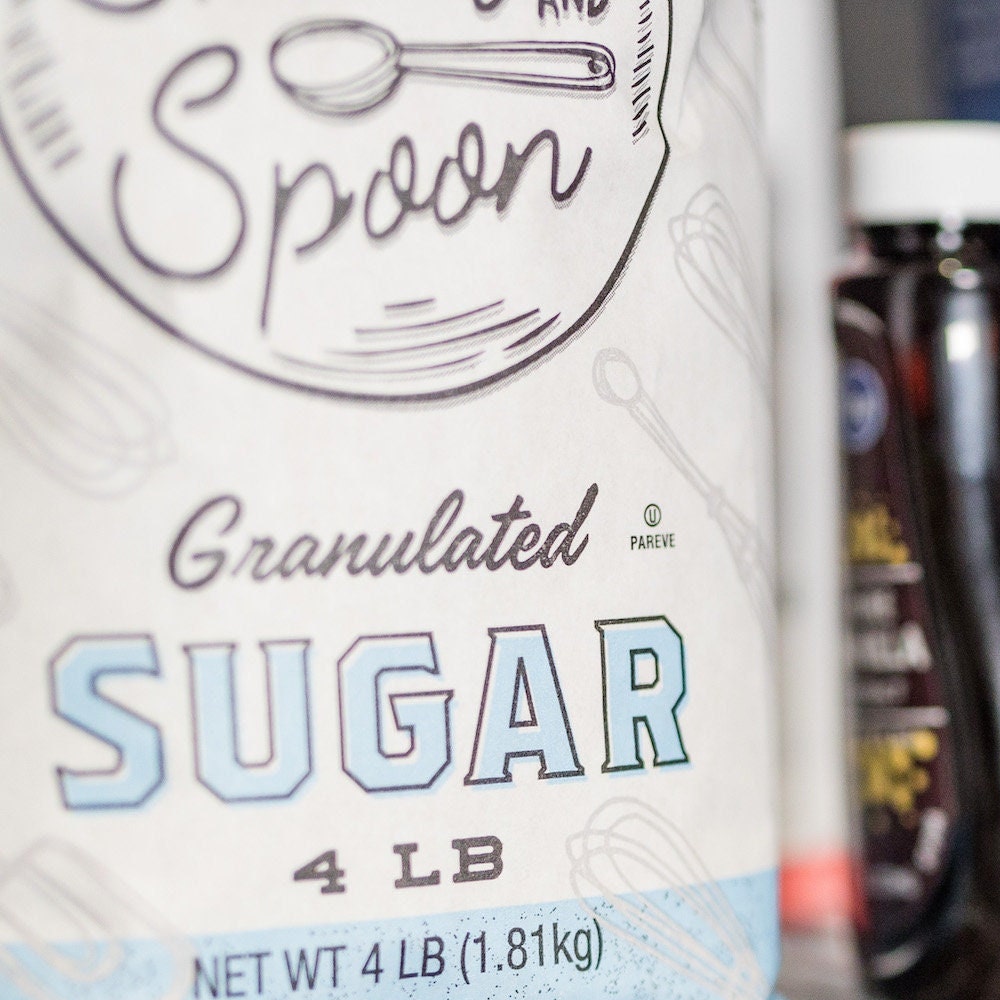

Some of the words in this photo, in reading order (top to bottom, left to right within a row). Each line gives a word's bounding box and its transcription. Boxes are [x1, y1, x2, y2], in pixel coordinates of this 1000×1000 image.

[112, 44, 593, 336] Spoon
[168, 482, 600, 591] Granulated
[630, 533, 676, 550] PAREVE
[48, 614, 690, 810] SUGAR
[293, 849, 346, 895] 4
[393, 835, 504, 889] LB
[193, 951, 272, 1000] NET
[284, 944, 347, 992] WT
[361, 942, 385, 984] 4
[399, 936, 446, 980] LB
[460, 918, 604, 985] (1.81kg)
